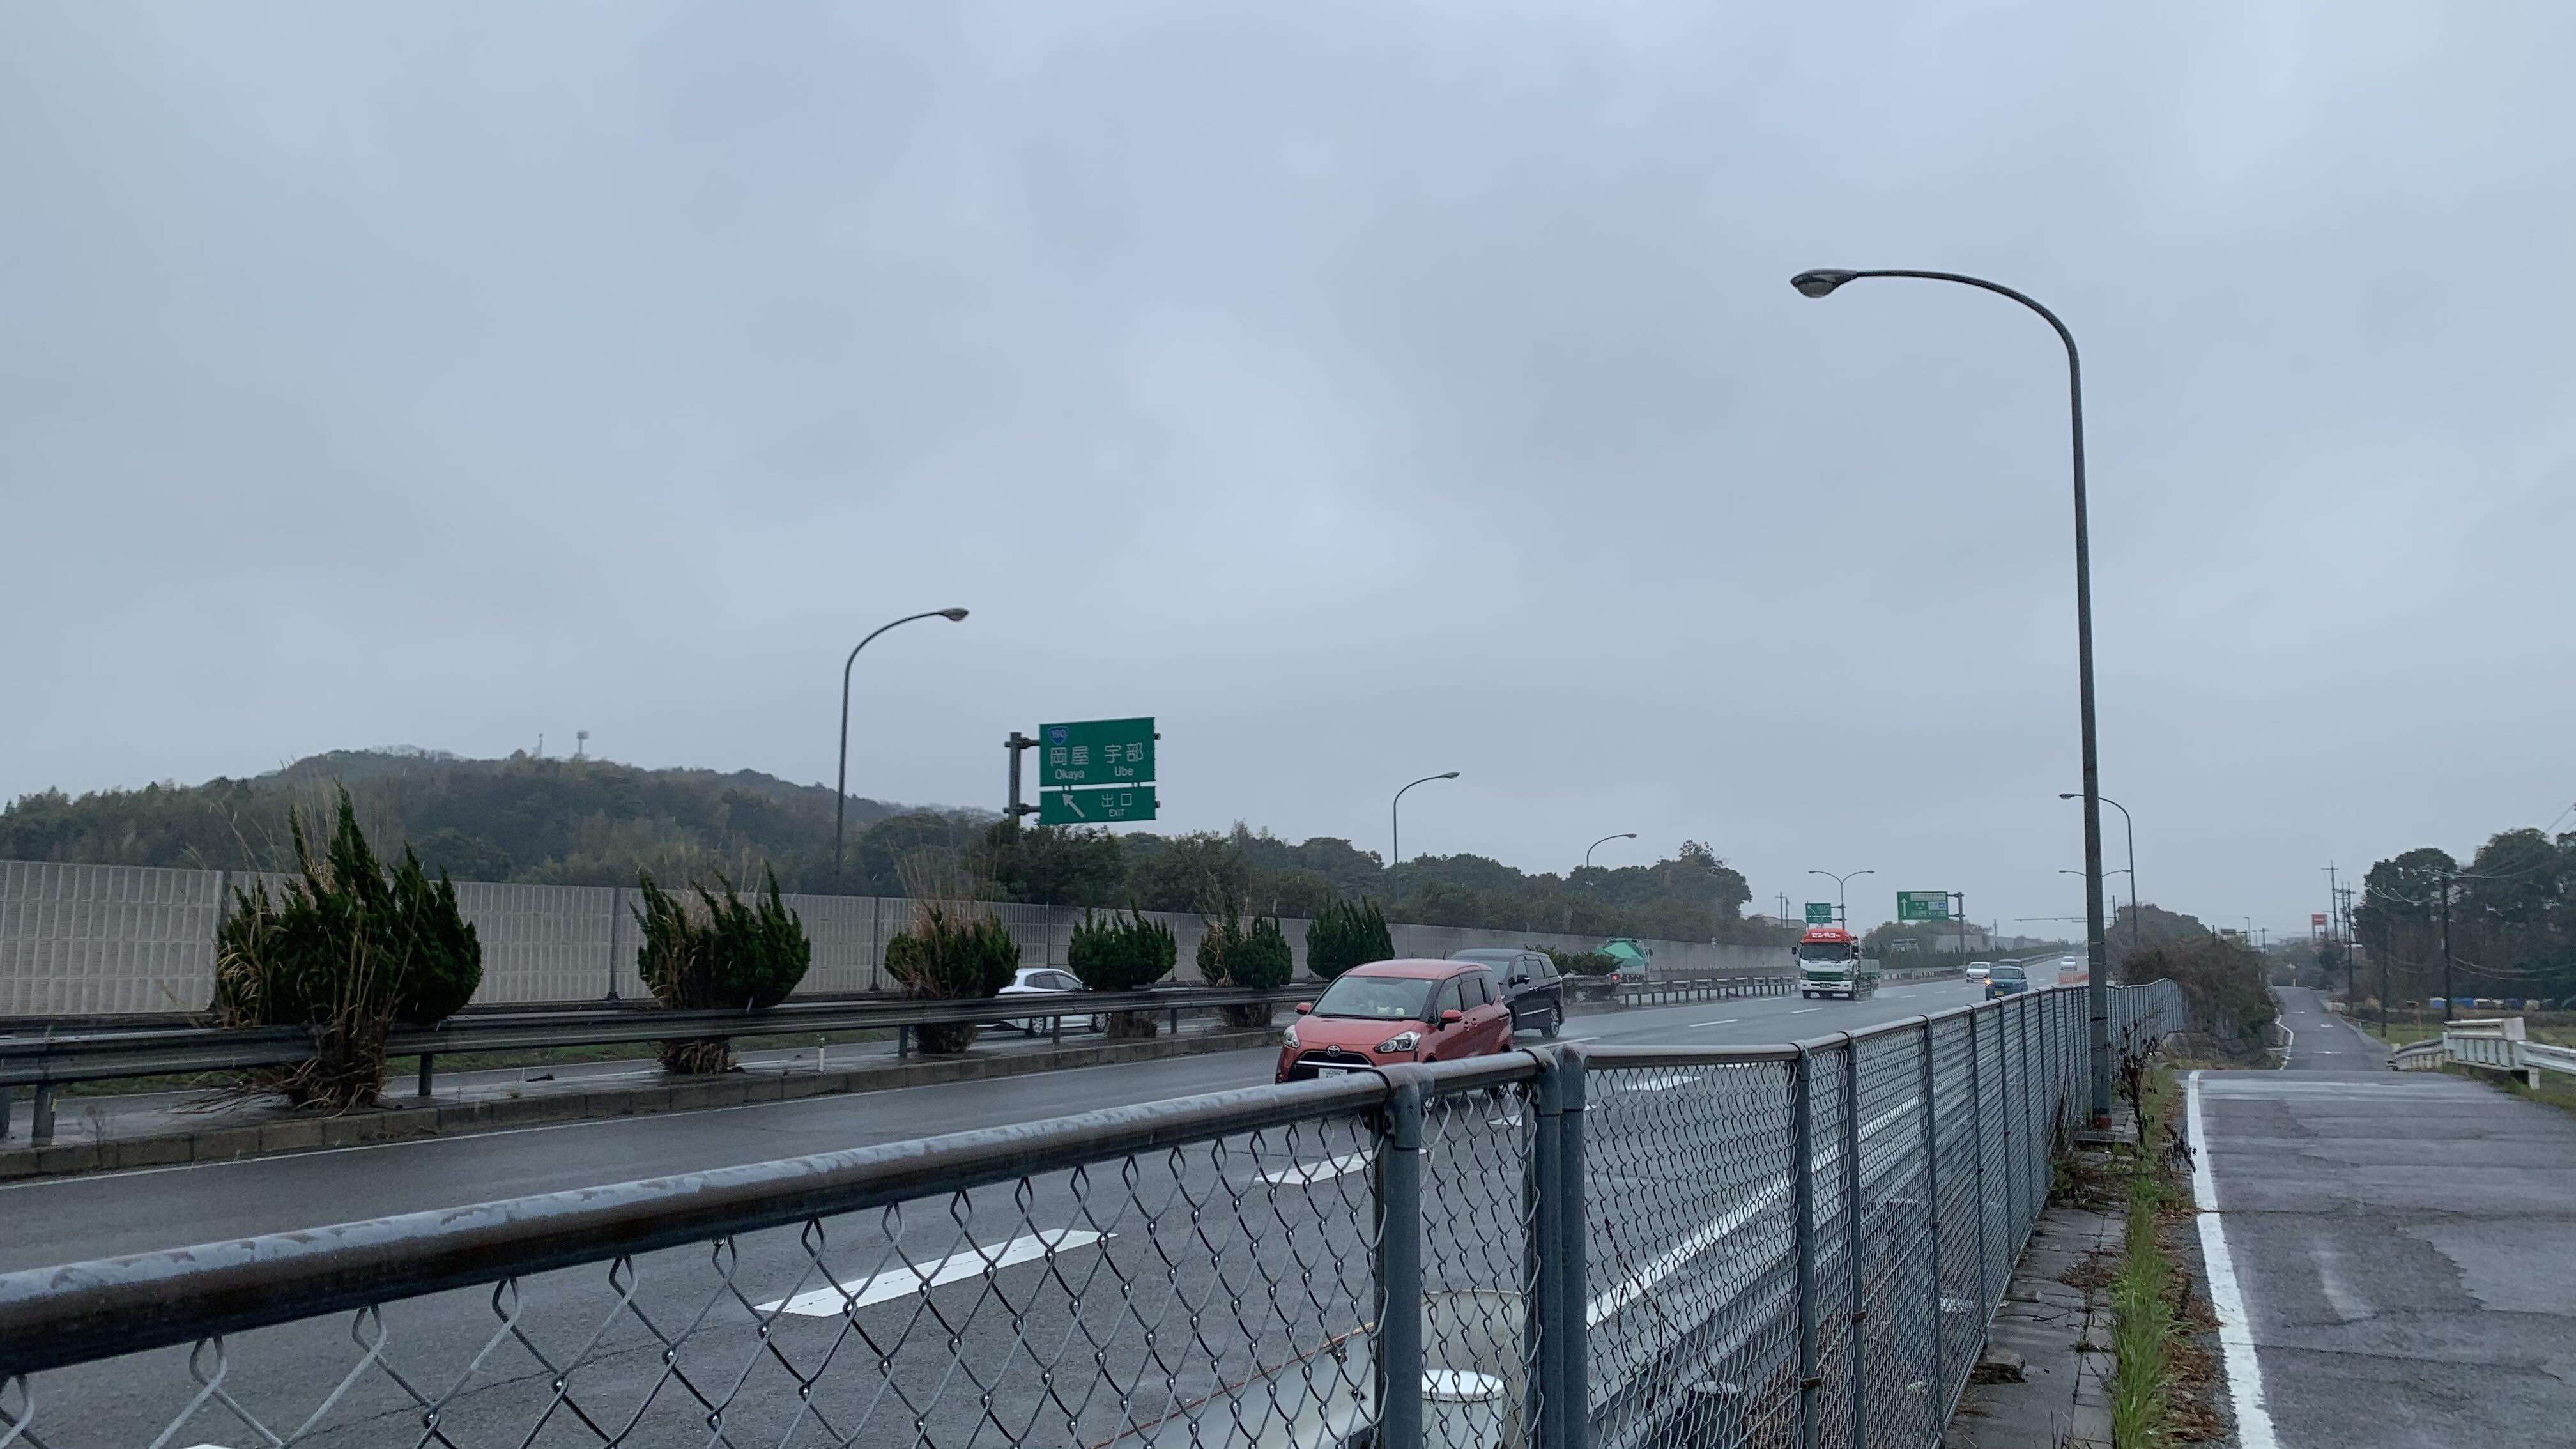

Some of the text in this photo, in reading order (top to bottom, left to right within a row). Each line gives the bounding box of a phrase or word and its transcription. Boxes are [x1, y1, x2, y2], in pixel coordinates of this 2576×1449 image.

[1050, 742, 1144, 767] 岡屋 宇部
[1055, 766, 1134, 781] Okaya Ube
[1101, 793, 1133, 808] 出口
[1108, 809, 1125, 817] EXIT
